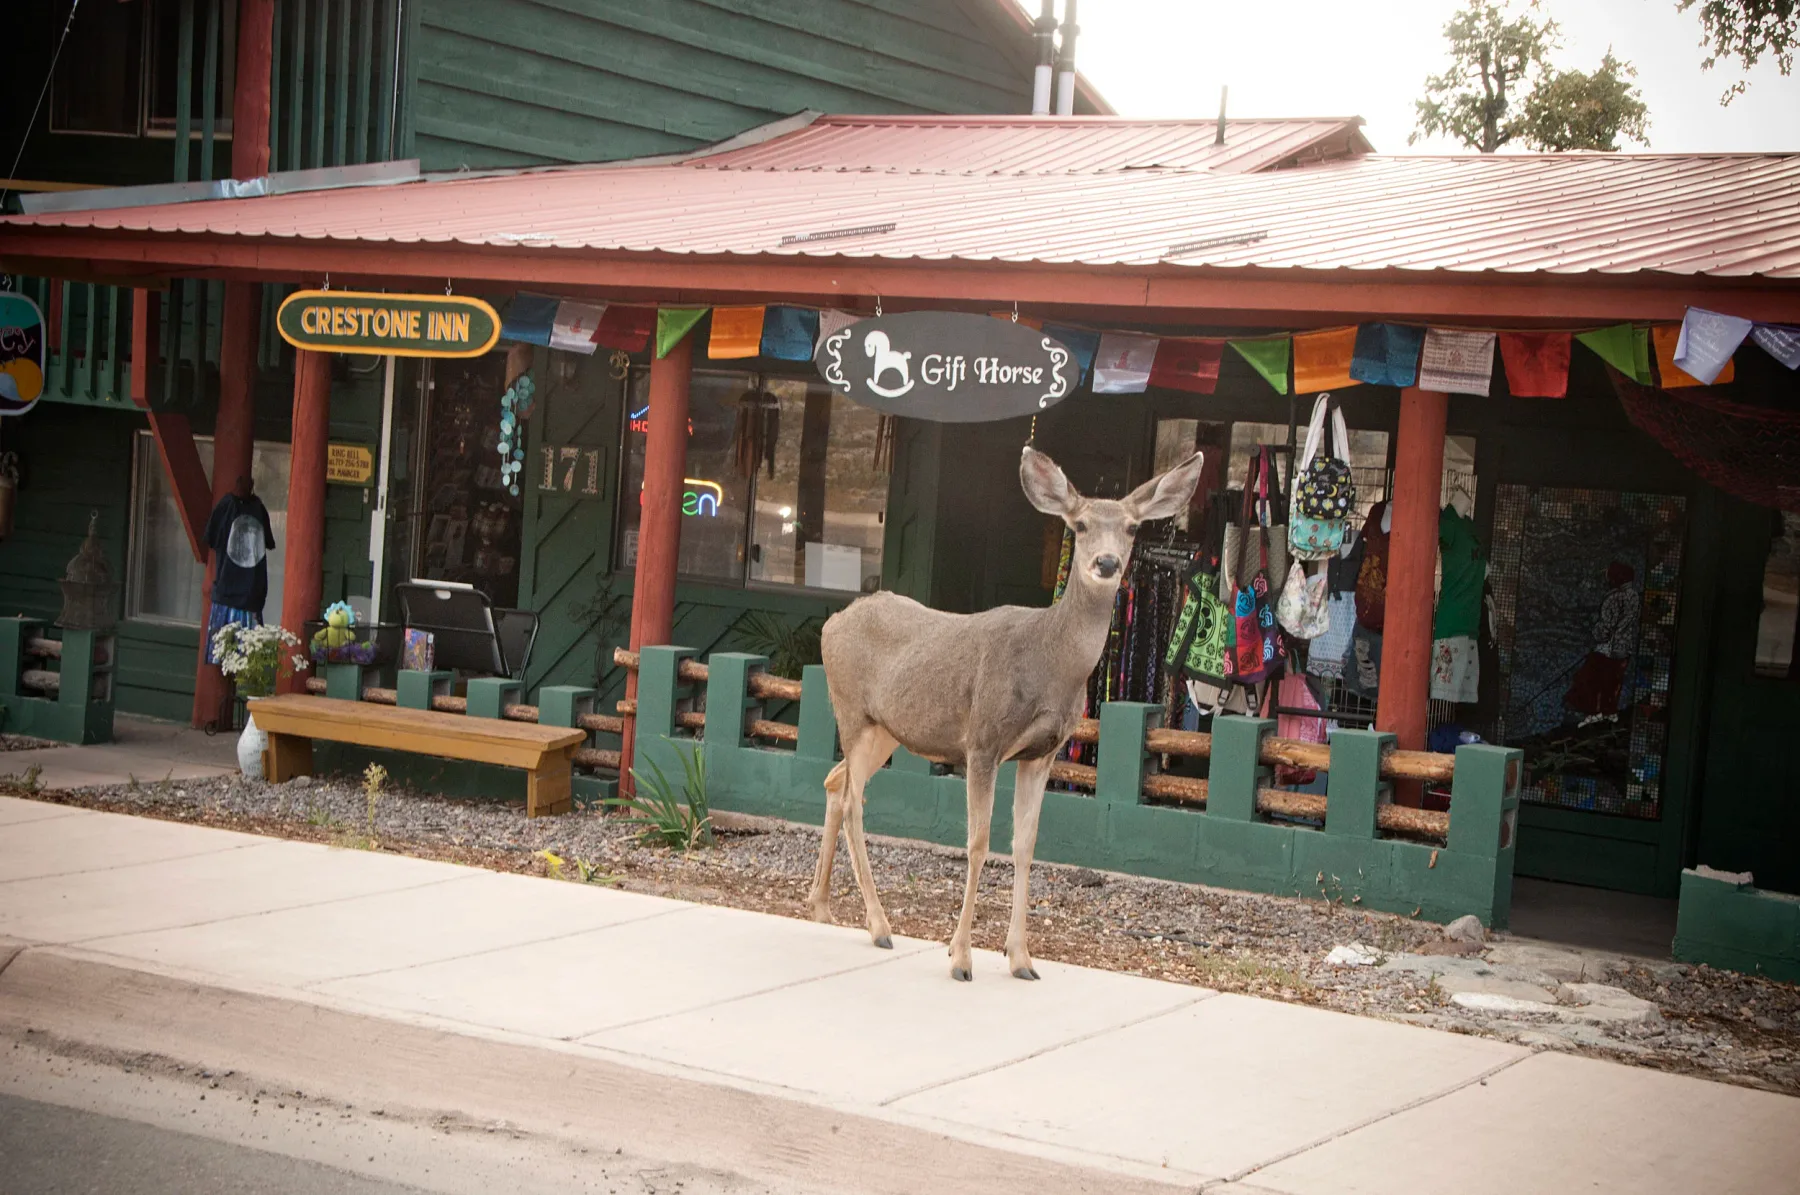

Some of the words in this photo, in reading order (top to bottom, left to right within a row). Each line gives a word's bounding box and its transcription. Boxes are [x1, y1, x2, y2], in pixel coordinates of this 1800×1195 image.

[301, 306, 421, 339] CRESTONE
[427, 311, 470, 342] INN
[921, 354, 966, 391] Gift
[973, 357, 1044, 385] Horse
[538, 445, 599, 495] 171
